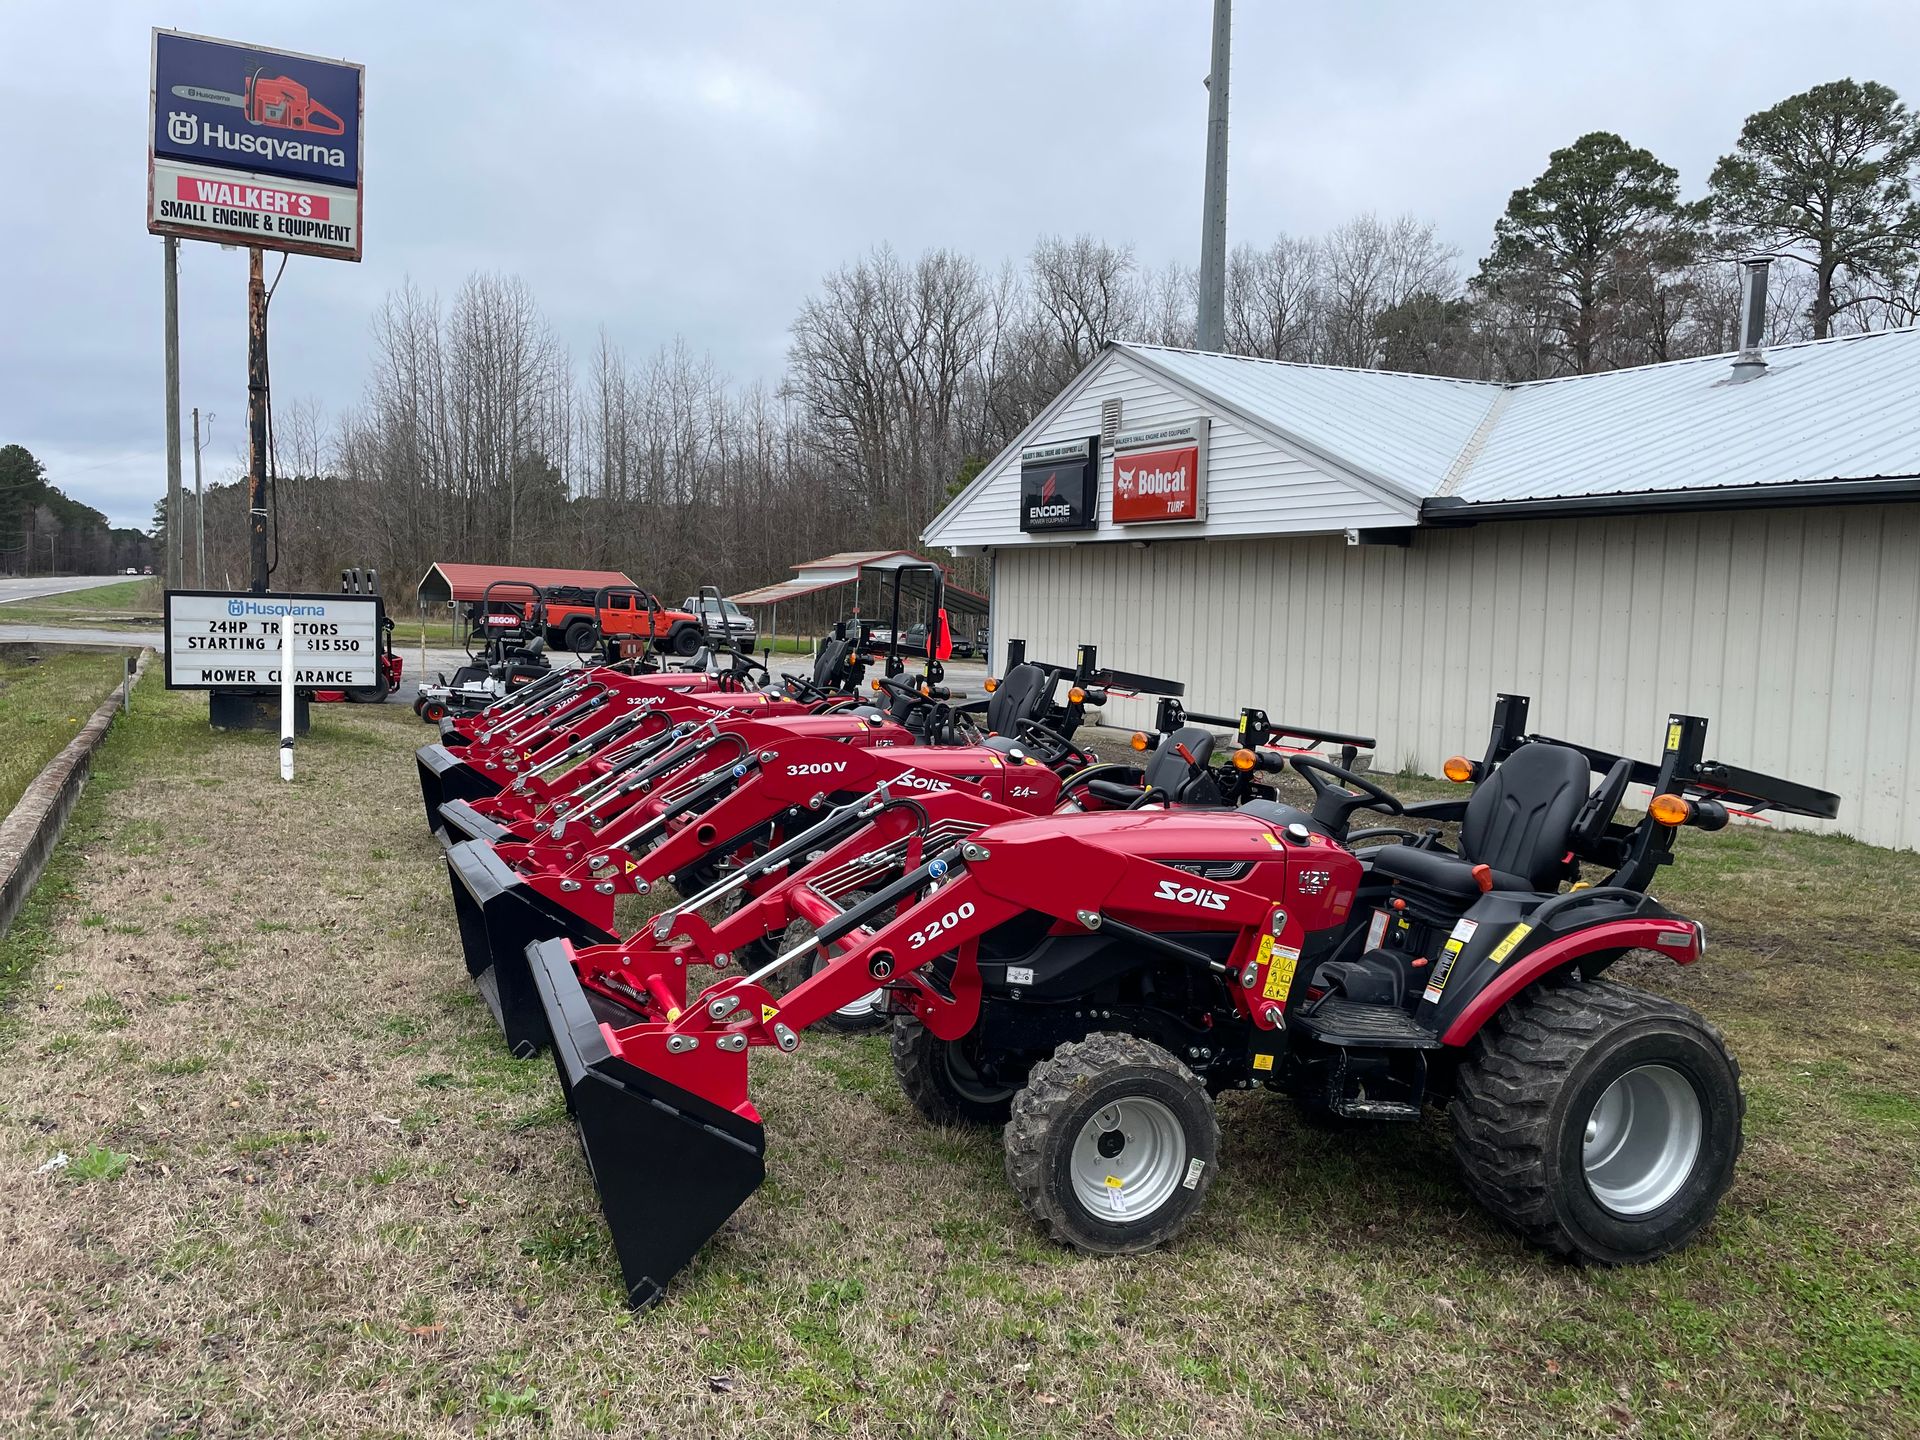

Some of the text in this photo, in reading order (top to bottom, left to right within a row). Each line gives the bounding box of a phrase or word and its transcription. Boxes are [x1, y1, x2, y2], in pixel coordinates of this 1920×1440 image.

[203, 122, 345, 168] Husqvarna
[196, 180, 312, 216] WALKER'S
[160, 200, 351, 243] SMALL ENGINE & EQUIPMENT
[1168, 427, 1191, 437] EQUIPMENT
[1138, 466, 1186, 495] Bobcat
[1030, 504, 1070, 518] ENCORE
[1166, 500, 1185, 514] TURF
[1046, 516, 1070, 524] EQUIPMENT
[245, 602, 325, 617] Husqvarna
[209, 620, 338, 635] 24HP TRCTORS
[488, 616, 517, 625] REGON
[188, 636, 265, 650] STARTING
[201, 669, 353, 683] MOWER CLARANCE
[896, 773, 951, 793] Solis
[1153, 880, 1230, 911] Solis
[907, 902, 976, 950] 3200
